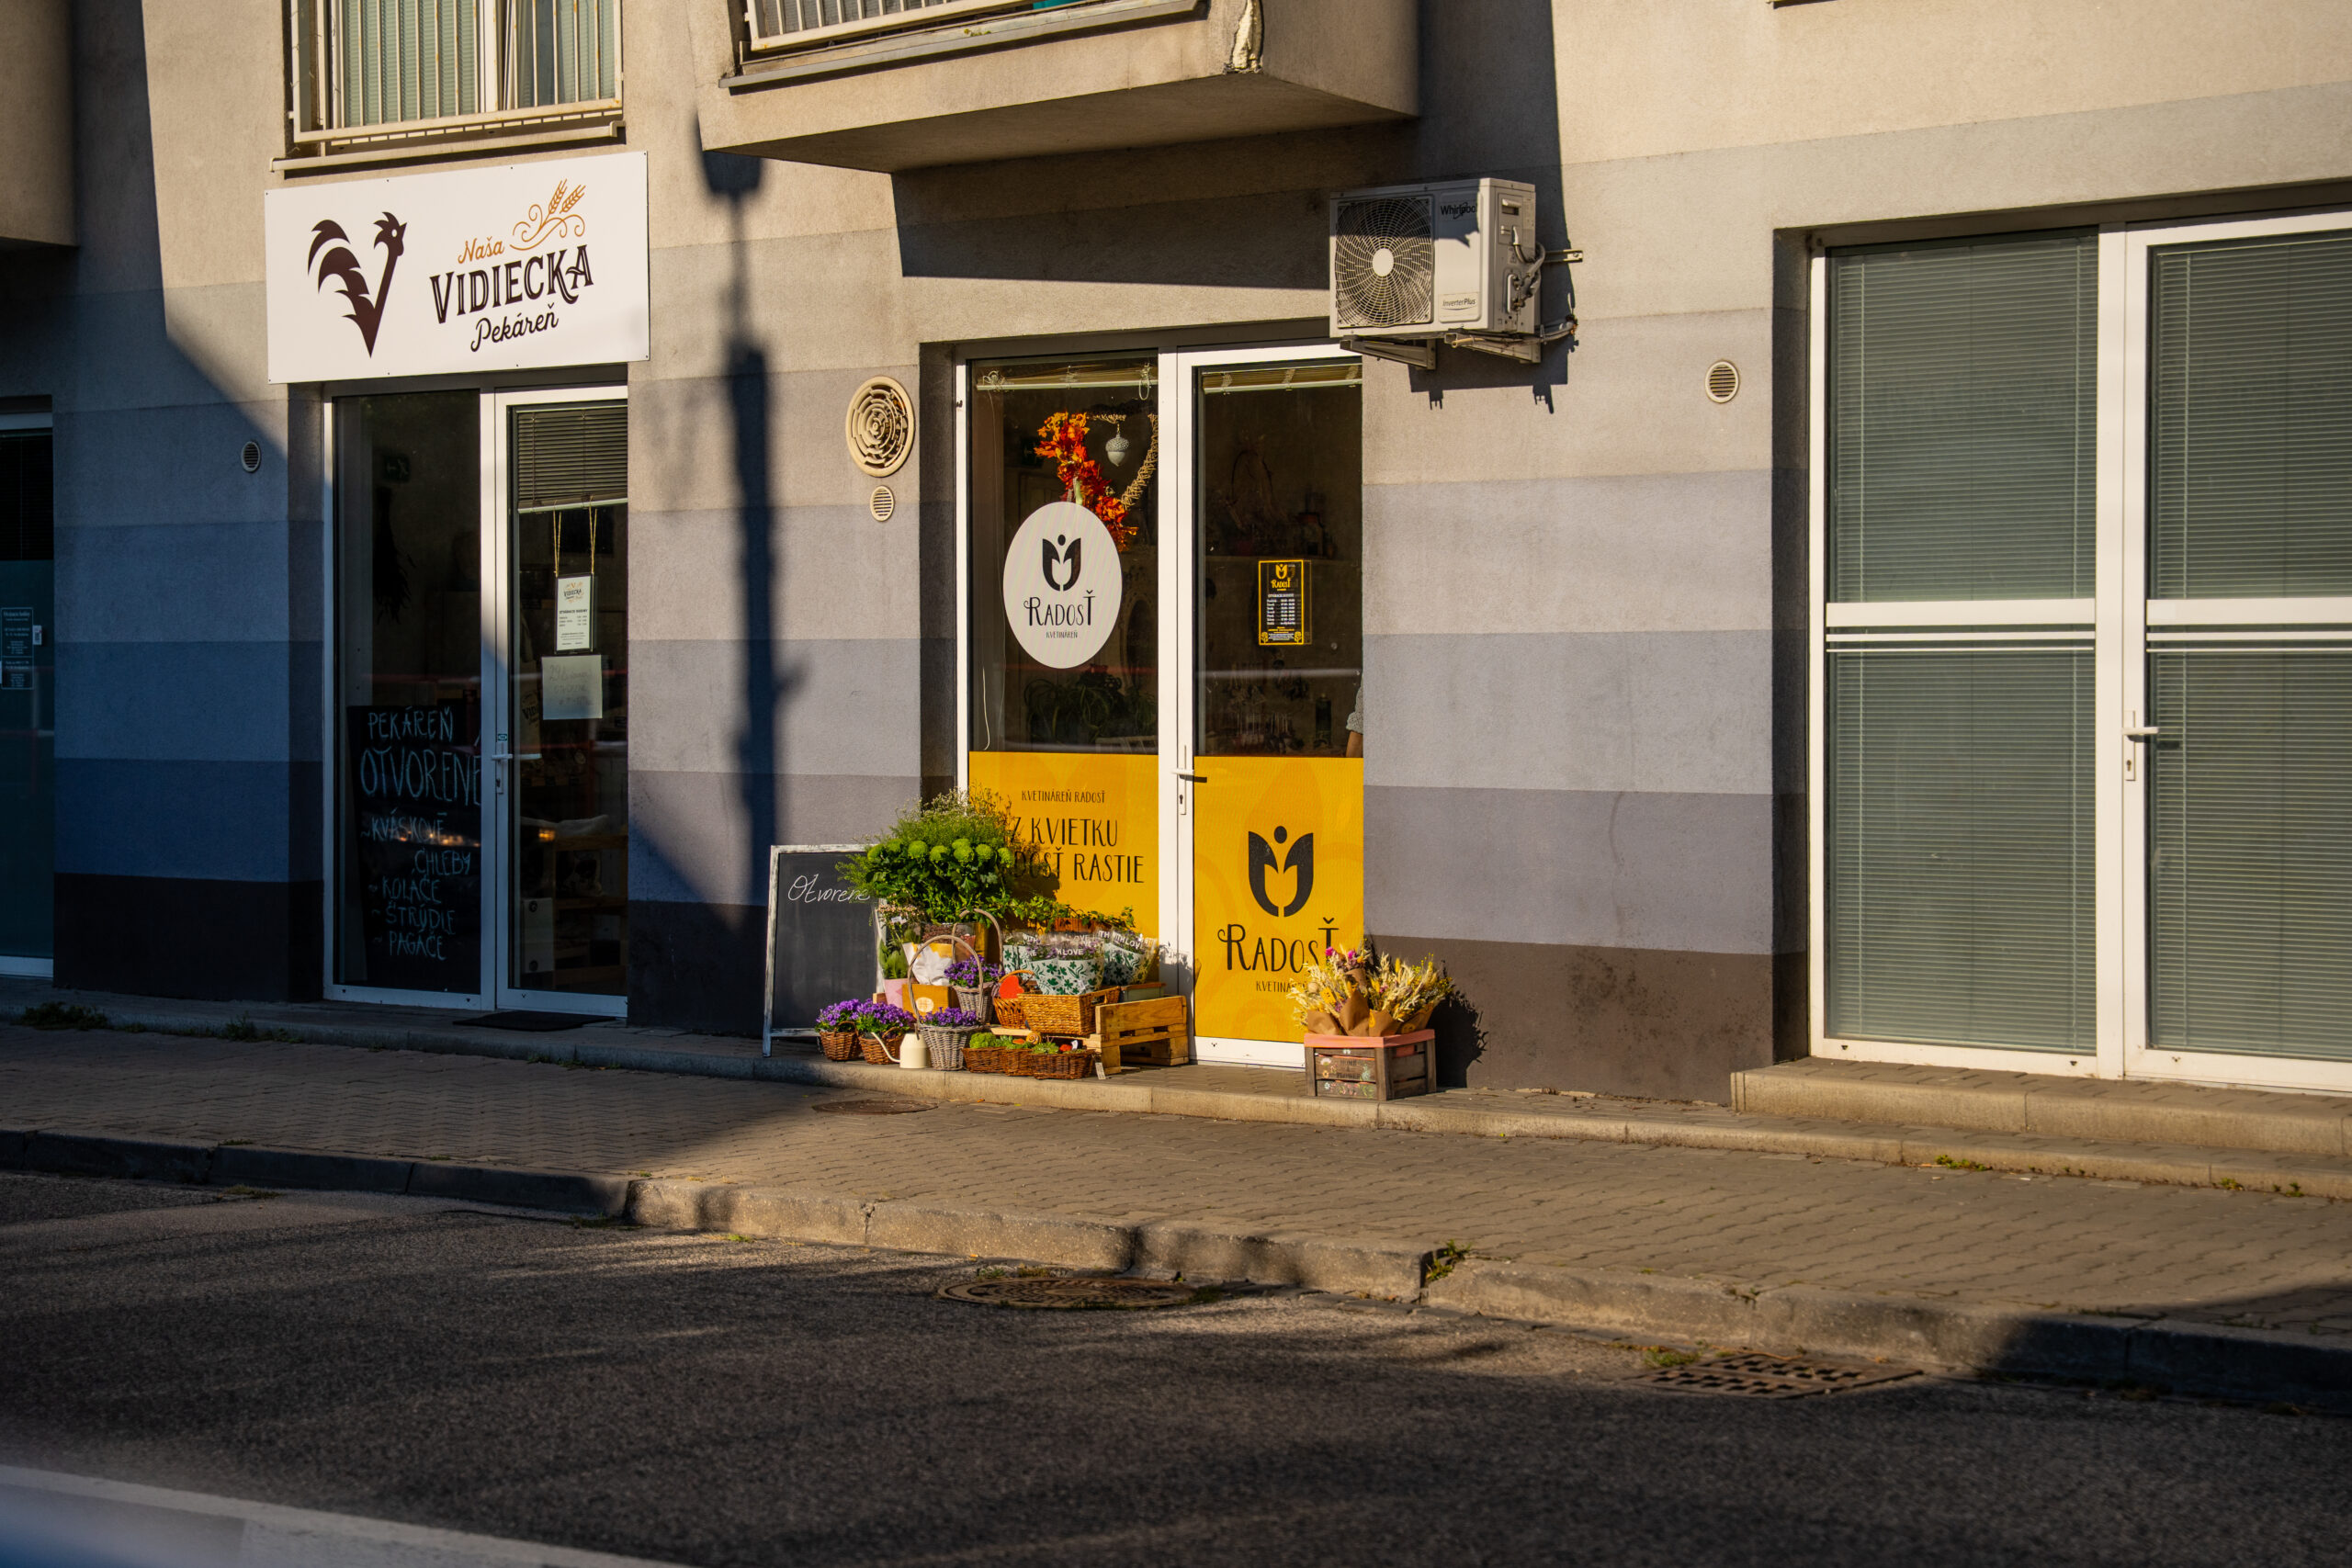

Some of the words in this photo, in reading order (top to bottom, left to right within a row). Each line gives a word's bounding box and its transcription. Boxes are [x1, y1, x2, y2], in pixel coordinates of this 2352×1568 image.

[458, 236, 505, 264] Naša
[429, 243, 594, 324] VIDIECKA
[470, 302, 559, 353] Pekáreň
[1023, 590, 1095, 626] RADOSŤ
[1046, 630, 1078, 639] KVETINÁREŇ
[368, 705, 454, 741] PEKÁREŇ
[1021, 788, 1071, 803] KVETINÁREŇ
[1074, 790, 1106, 804] RADOSŤ
[1011, 817, 1022, 844] Z
[1031, 818, 1118, 847] KVIETKU
[1013, 847, 1064, 879] DOSŤ
[1074, 853, 1145, 884] RASTIE
